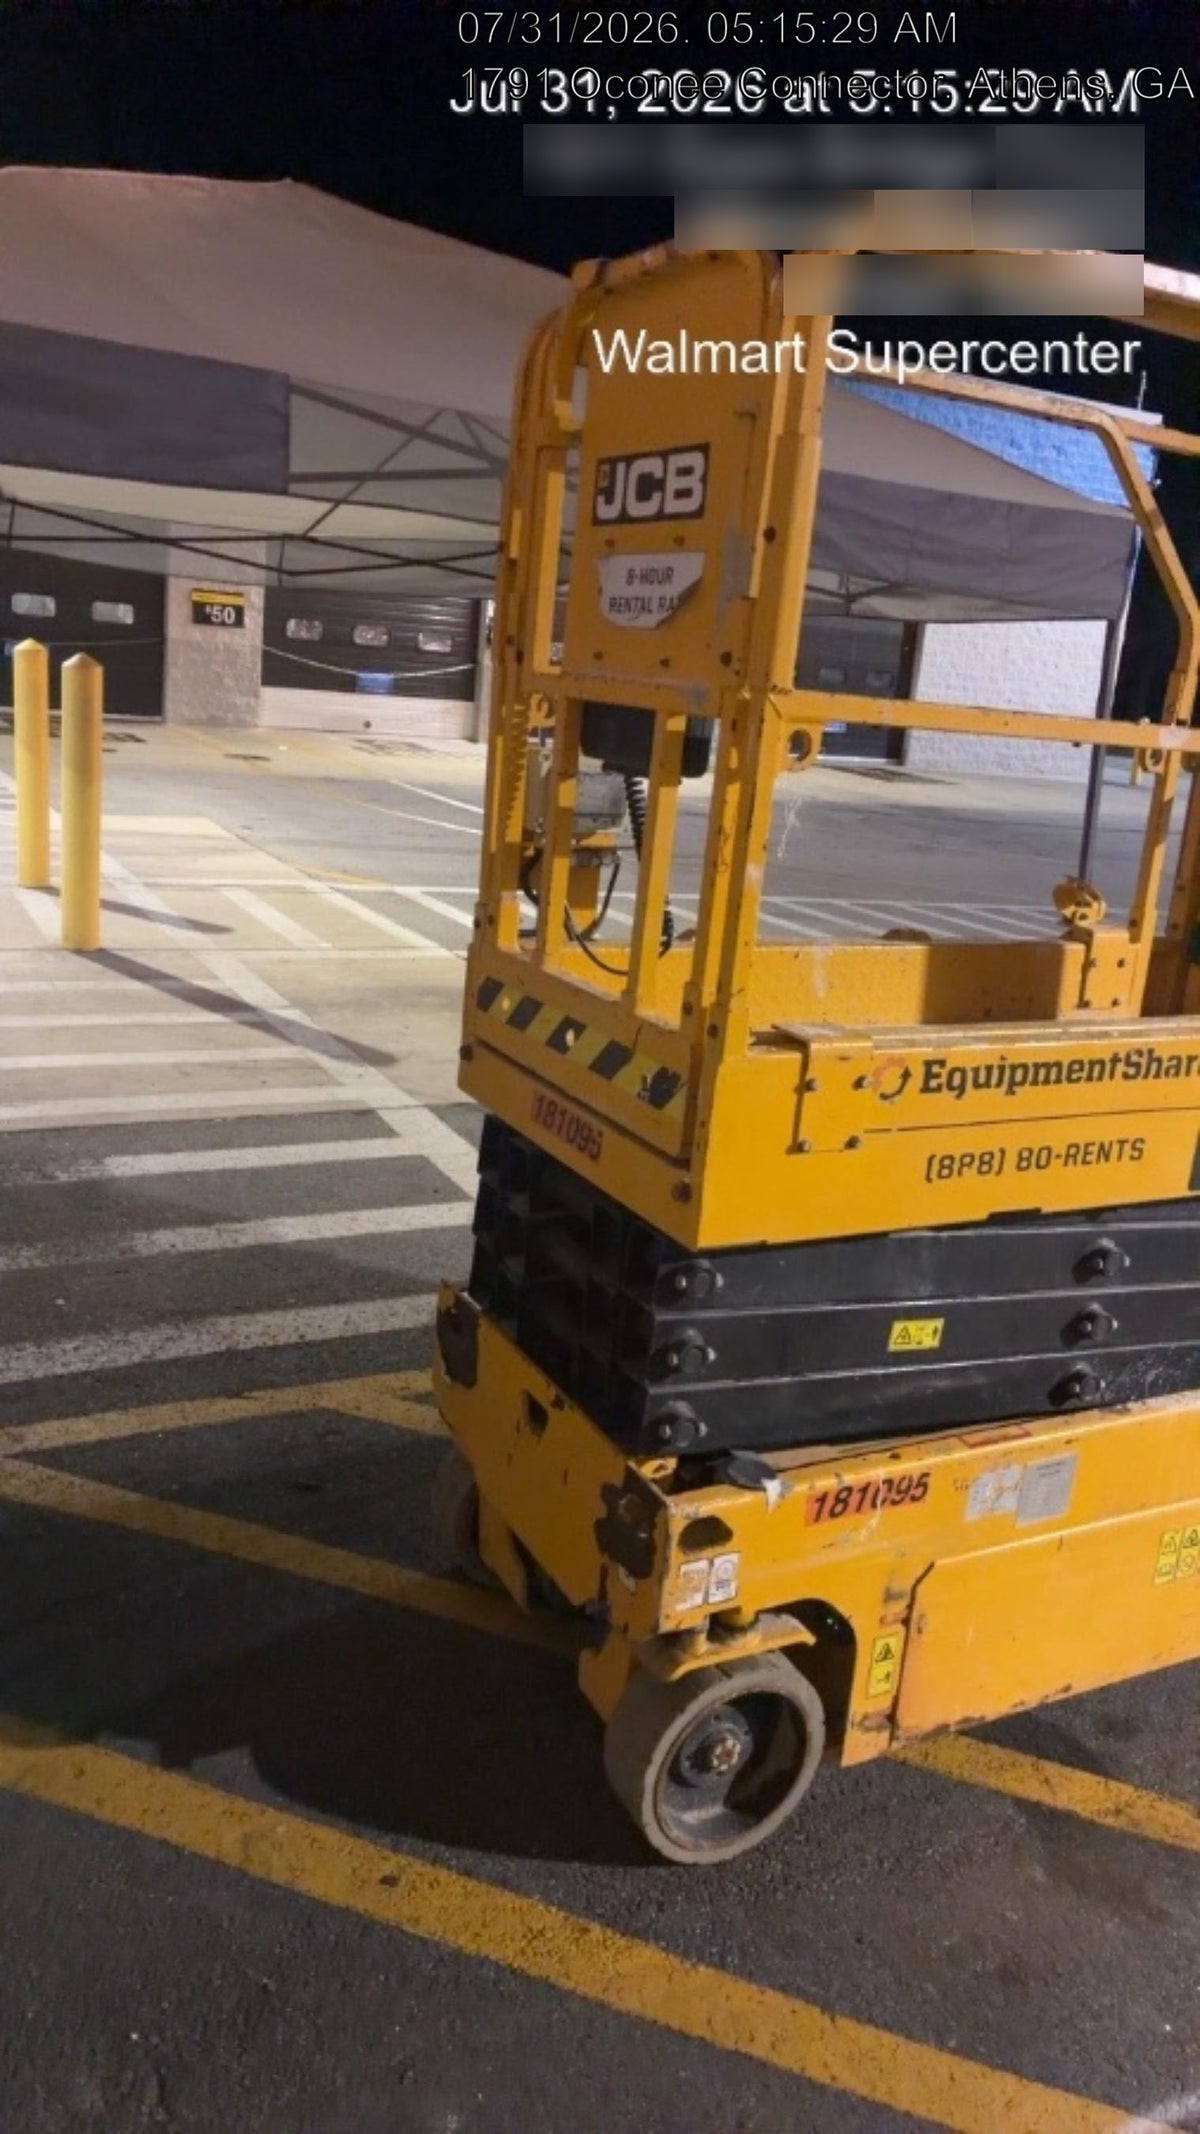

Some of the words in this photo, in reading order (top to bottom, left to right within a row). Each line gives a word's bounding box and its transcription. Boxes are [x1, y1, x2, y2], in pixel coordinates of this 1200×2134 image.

[595, 450, 706, 521] JCB
[625, 565, 675, 587] 8-HOUR
[608, 595, 654, 615] RENTAL
[918, 1047, 1200, 1100] EquipmentShar
[533, 1093, 605, 1161] 181095
[1015, 1136, 1146, 1173] 80-RENTS
[812, 1471, 932, 1524] 181095
